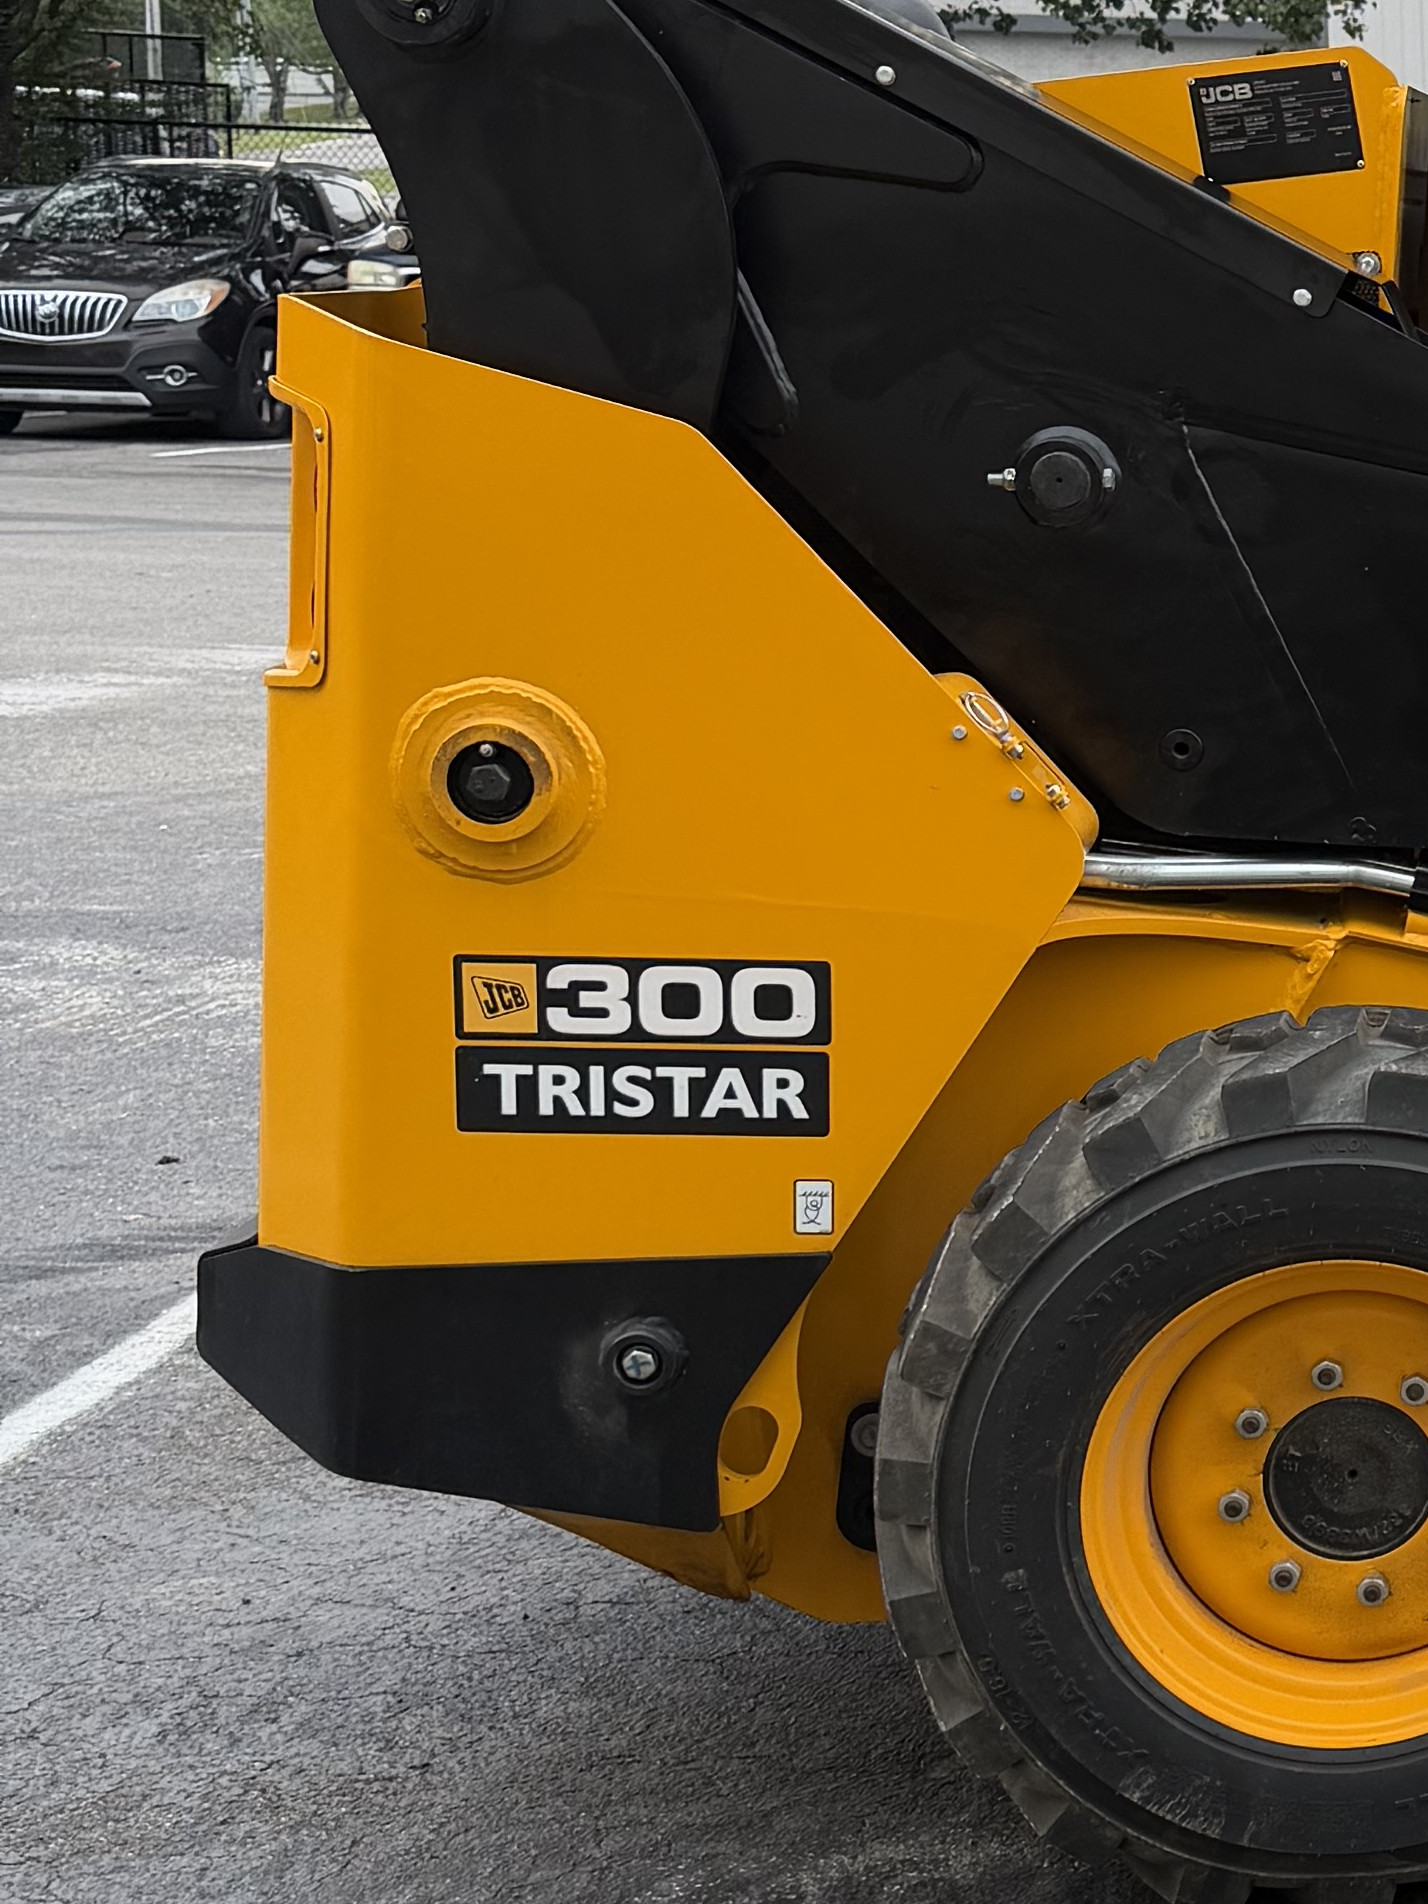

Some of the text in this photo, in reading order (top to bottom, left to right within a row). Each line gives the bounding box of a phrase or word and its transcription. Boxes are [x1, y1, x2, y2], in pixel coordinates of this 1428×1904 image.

[1199, 82, 1253, 104] JCB
[480, 963, 817, 1038] JCB 300
[482, 1063, 810, 1120] TRISTAR
[1066, 1196, 1290, 1328] XTRA-WALL
